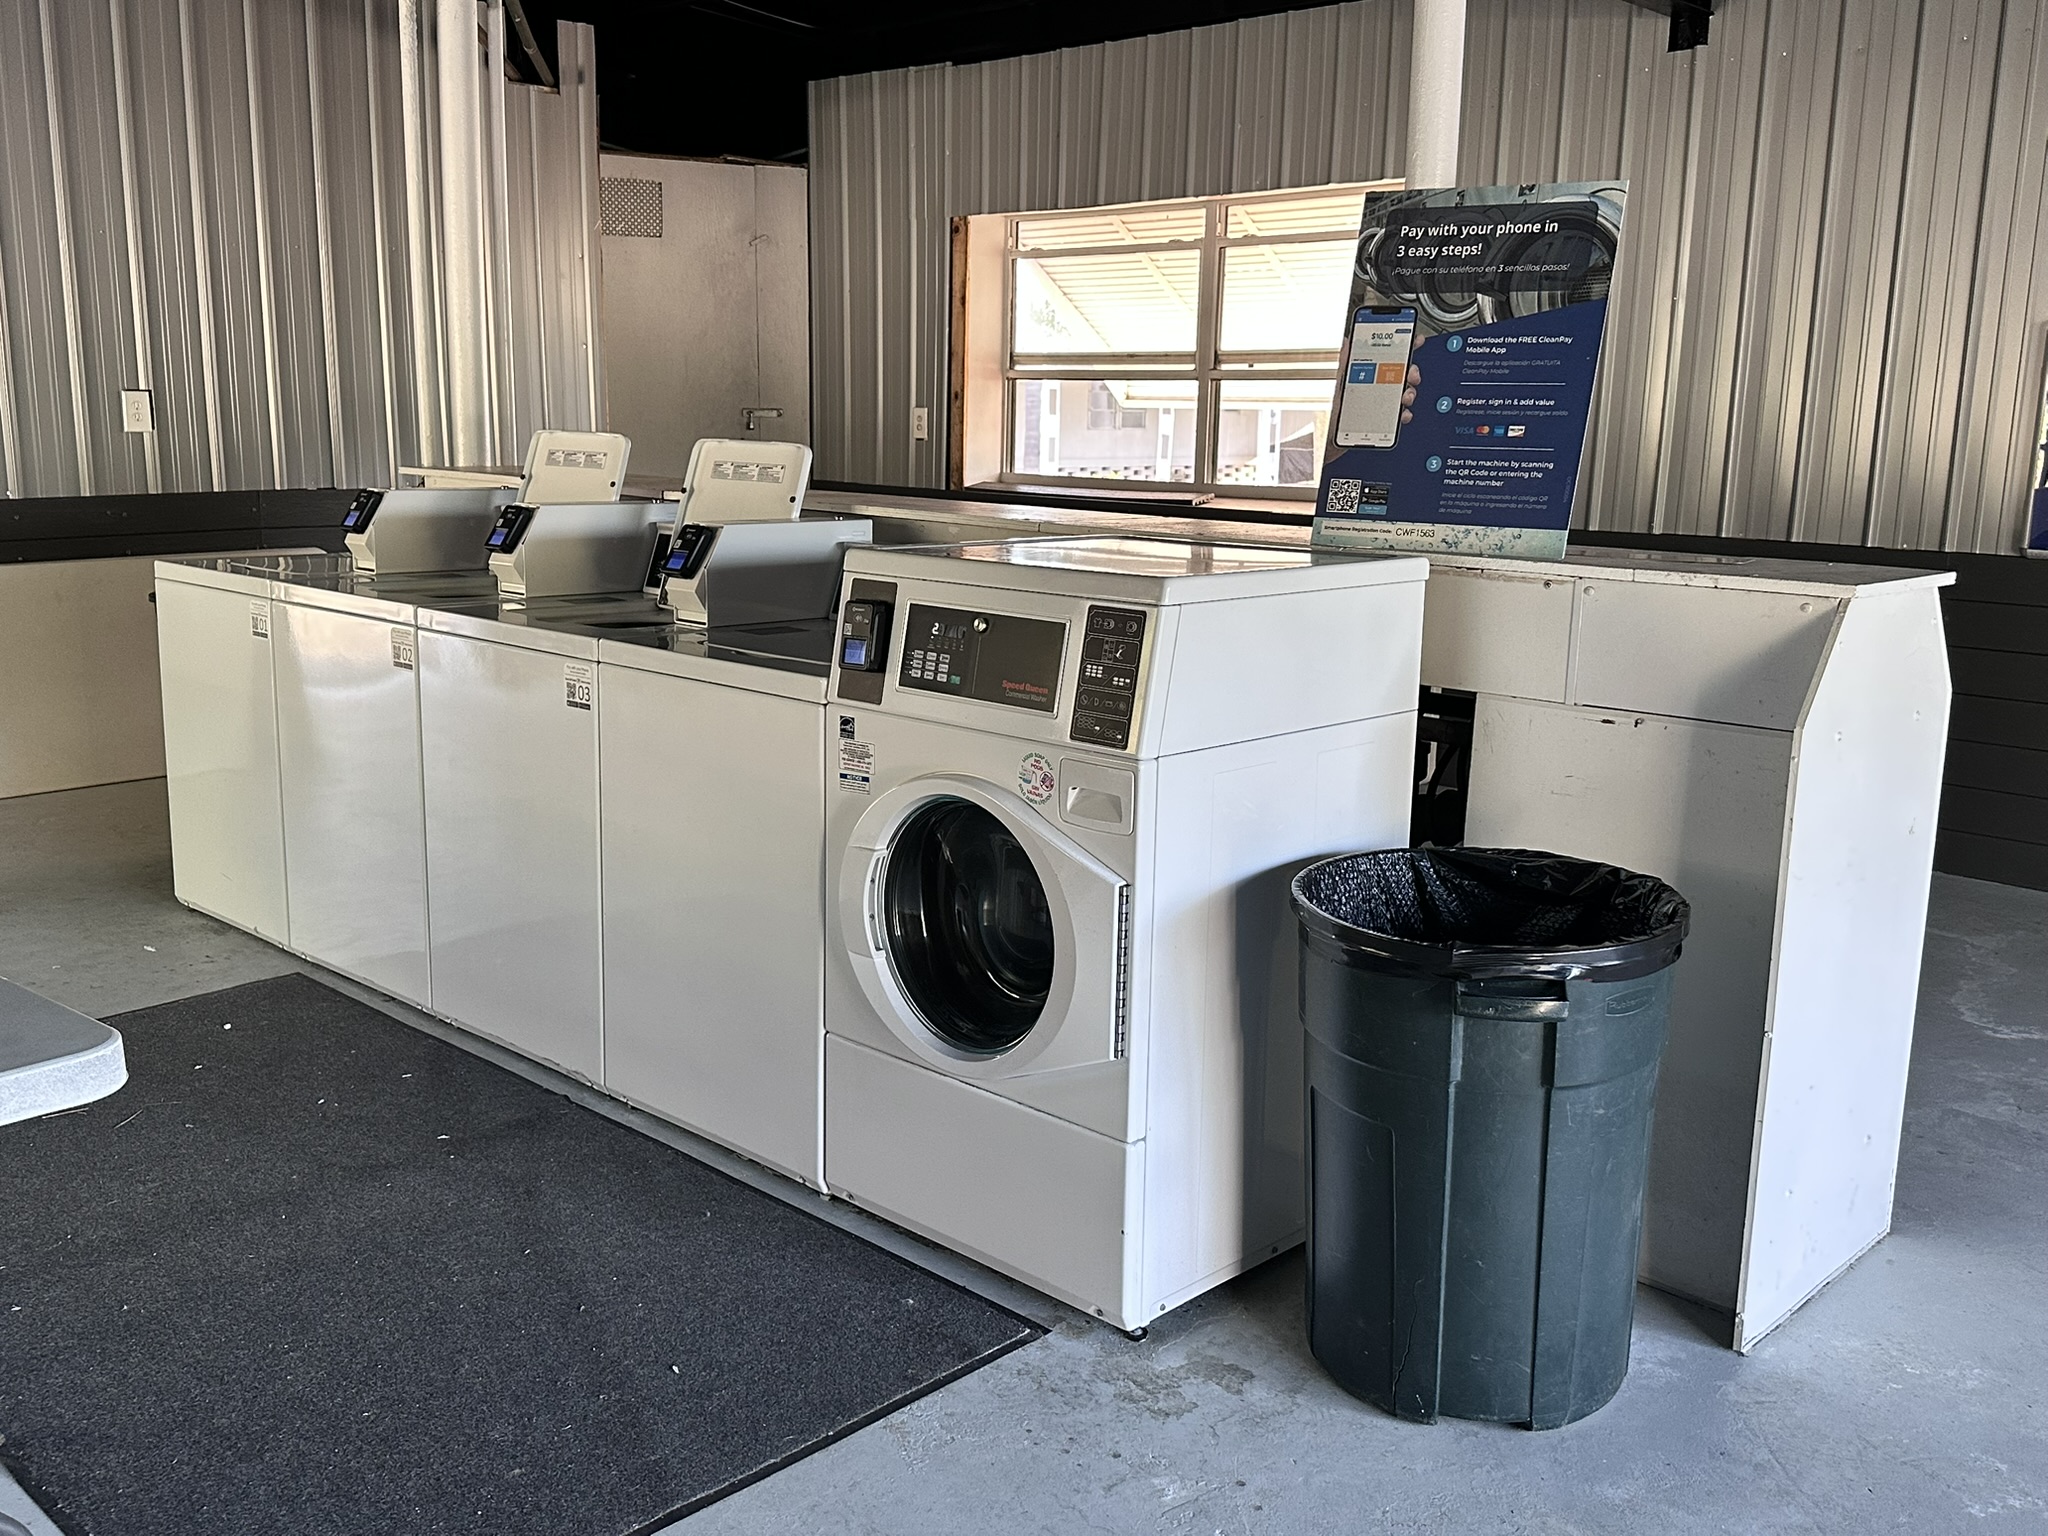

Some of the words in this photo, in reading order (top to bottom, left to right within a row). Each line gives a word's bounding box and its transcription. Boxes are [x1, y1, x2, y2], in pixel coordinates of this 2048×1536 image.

[1400, 225, 1424, 240] Pay
[1428, 222, 1458, 236] with
[1460, 224, 1494, 238] your
[1496, 221, 1541, 237] phone
[1545, 219, 1559, 233] in
[1397, 245, 1405, 257] 3
[1408, 246, 1438, 259] easy
[1441, 243, 1483, 258] steps!
[1450, 265, 1484, 274] teléfono
[1497, 264, 1504, 273] 3
[1504, 264, 1540, 273] sencillos
[1541, 263, 1570, 273] pasos!
[1371, 332, 1394, 340] $10.00
[1467, 336, 1504, 344] Download
[1538, 335, 1573, 344] CleanPay
[1452, 339, 1457, 348] 1
[1465, 346, 1490, 354] Mobile
[1491, 346, 1507, 355] App
[1441, 401, 1447, 410] 2
[1456, 397, 1487, 406] Register,
[1488, 398, 1504, 407] sign
[1519, 398, 1534, 406] add
[1535, 398, 1555, 406] value
[1455, 426, 1474, 434] VISA
[1430, 459, 1437, 468] 3
[1510, 460, 1520, 469] by
[1520, 461, 1554, 469] scanning
[1498, 470, 1529, 479] entering
[1443, 478, 1474, 486] machine
[1475, 479, 1504, 487] number
[1395, 527, 1435, 538] CWF1563
[259, 618, 268, 632] 01
[402, 647, 413, 663] 02
[1002, 679, 1025, 690] Speed
[1025, 683, 1049, 695] Queen
[578, 685, 590, 702] 03
[1005, 689, 1030, 700] Commercial
[1030, 693, 1048, 703] Washer
